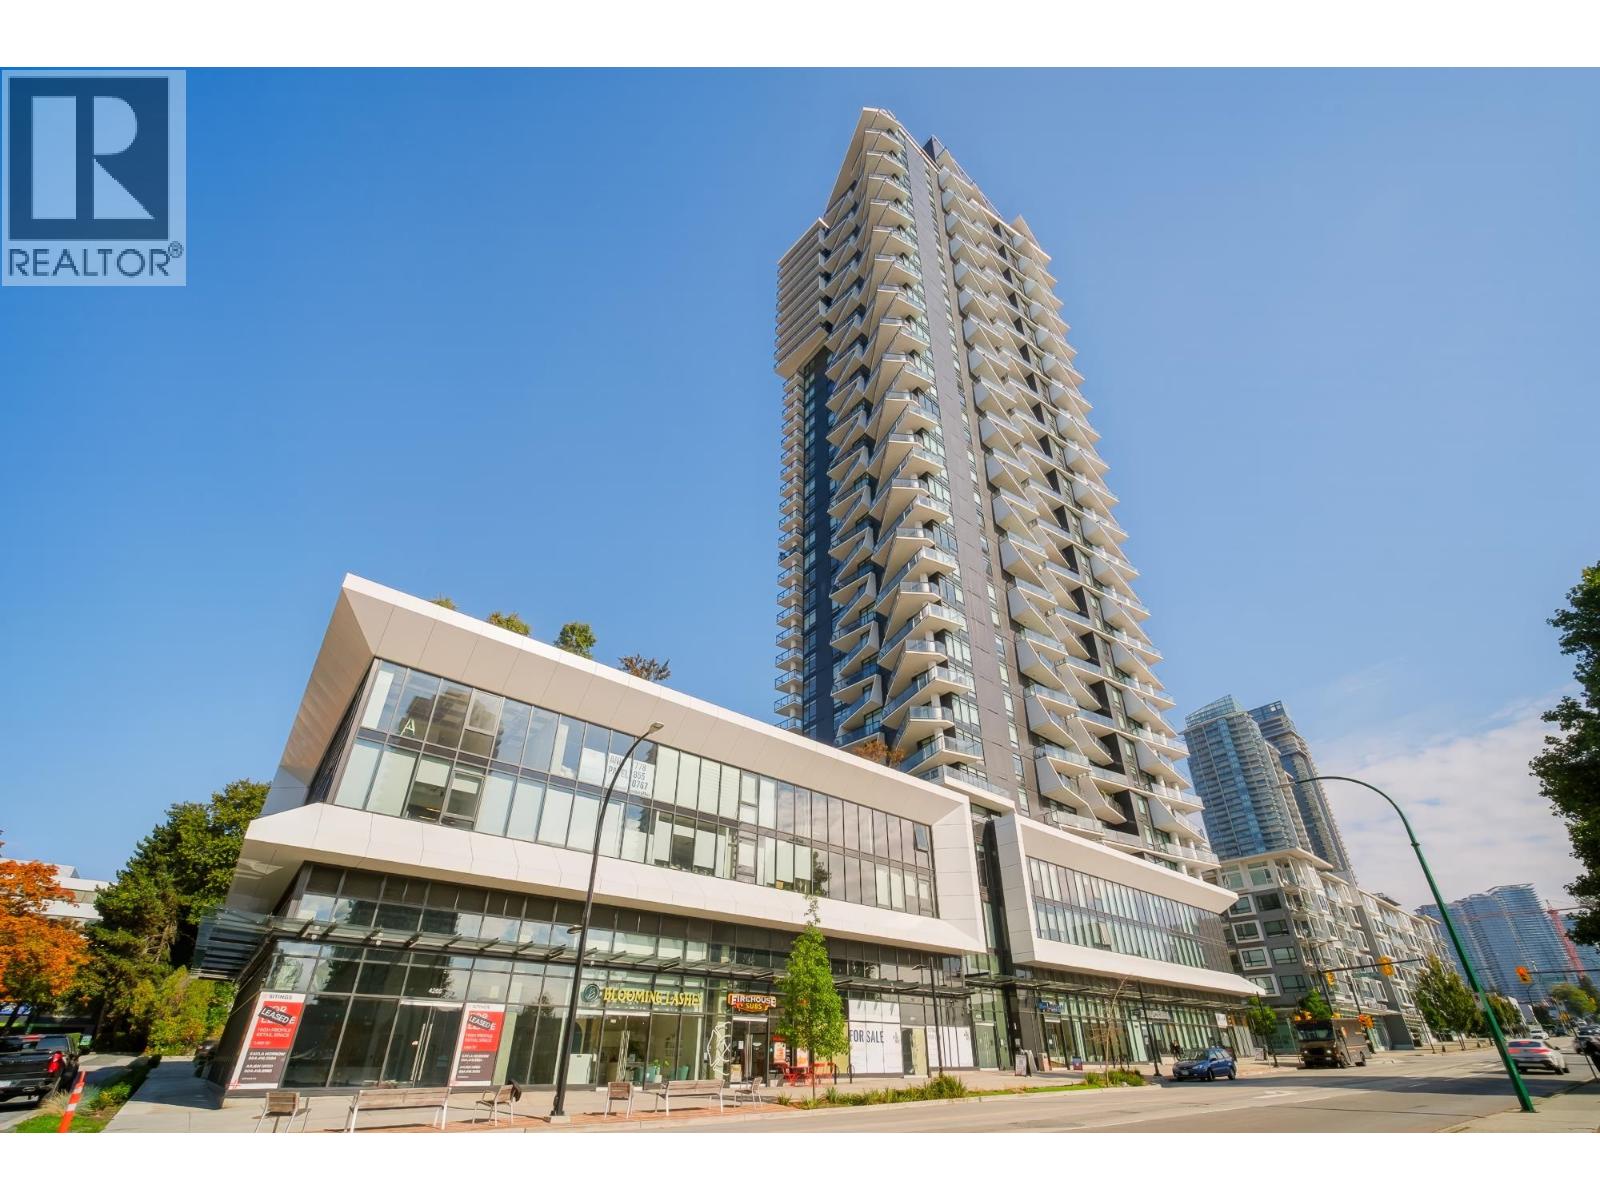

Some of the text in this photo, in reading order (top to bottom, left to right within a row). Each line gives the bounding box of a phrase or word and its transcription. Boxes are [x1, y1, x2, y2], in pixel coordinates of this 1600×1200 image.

[603, 987, 662, 1005] BLOOMING
[731, 994, 777, 1008] FIREHOUSE
[261, 1007, 290, 1023] LEASED
[469, 1015, 491, 1028] LEASED
[850, 1029, 885, 1044] FOR SALE
